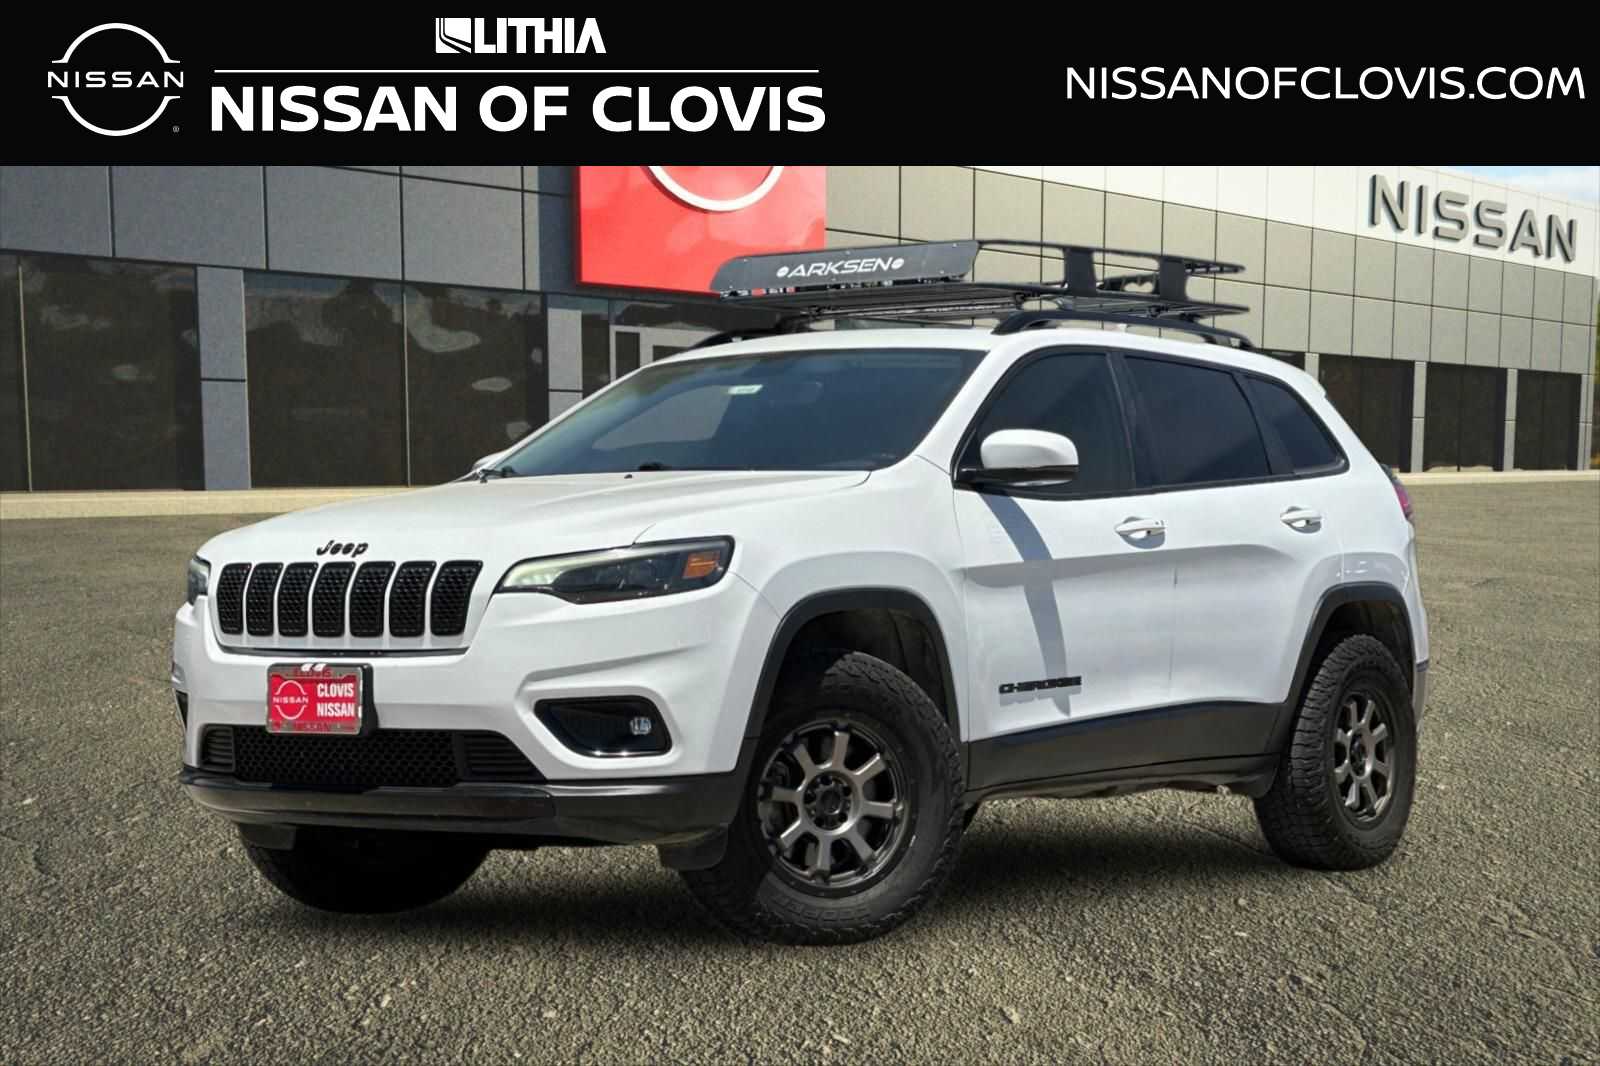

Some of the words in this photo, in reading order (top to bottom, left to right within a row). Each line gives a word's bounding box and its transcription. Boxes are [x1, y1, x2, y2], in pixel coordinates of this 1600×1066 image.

[1368, 174, 1577, 263] NISSAN
[787, 257, 894, 278] ARKSEN
[316, 540, 368, 558] Jeep
[317, 682, 354, 698] CLOVIS
[273, 696, 309, 704] NISSAN
[317, 702, 355, 717] NISSAN
